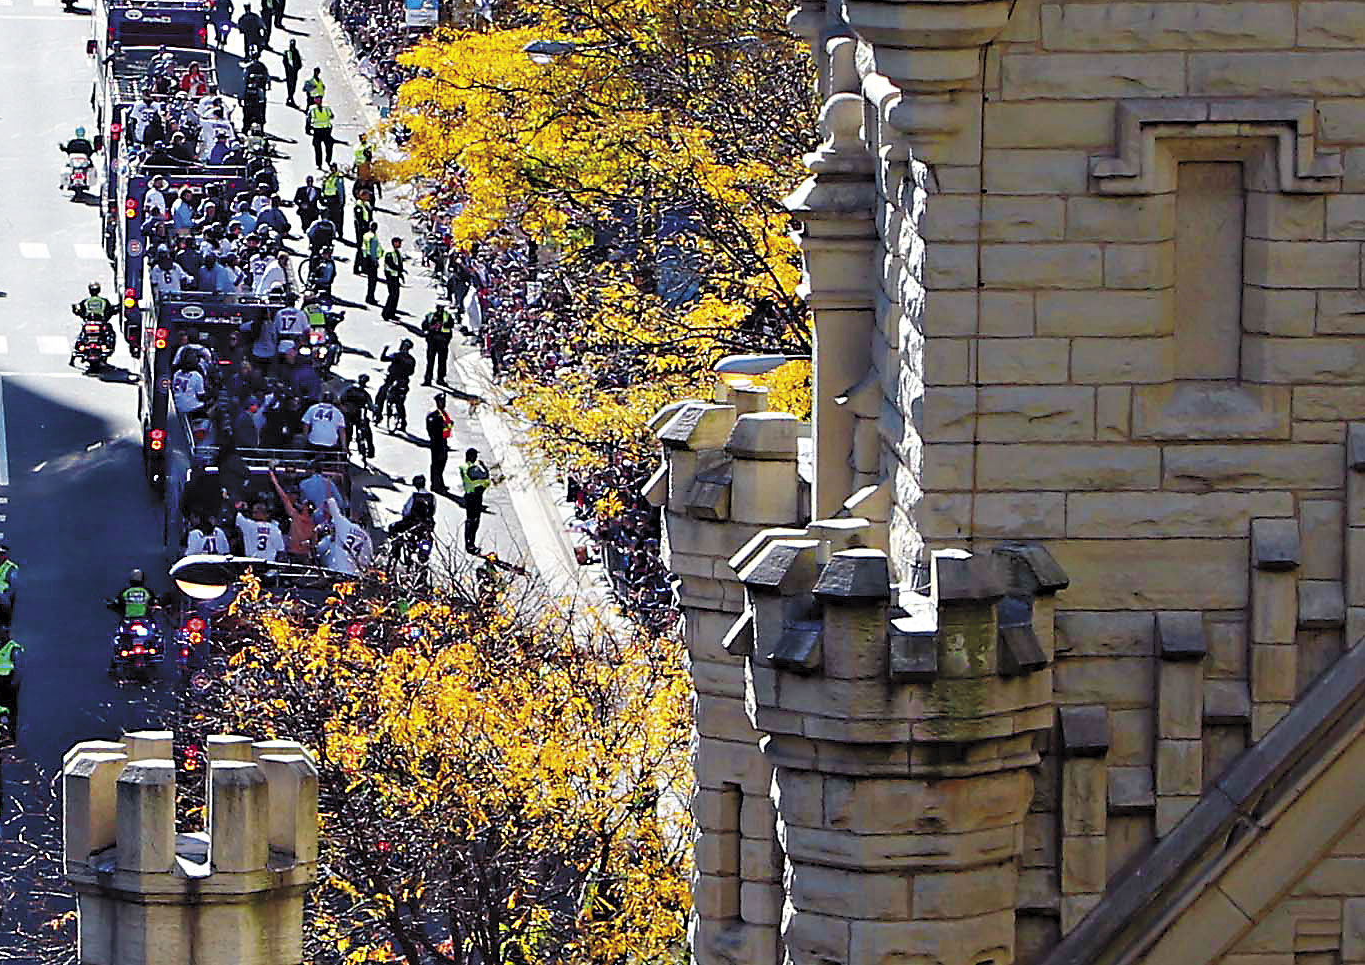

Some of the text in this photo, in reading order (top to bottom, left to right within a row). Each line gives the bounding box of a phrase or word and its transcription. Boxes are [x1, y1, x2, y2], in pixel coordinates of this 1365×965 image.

[281, 317, 296, 330] 17
[315, 409, 333, 421] 44
[257, 535, 267, 551] 3
